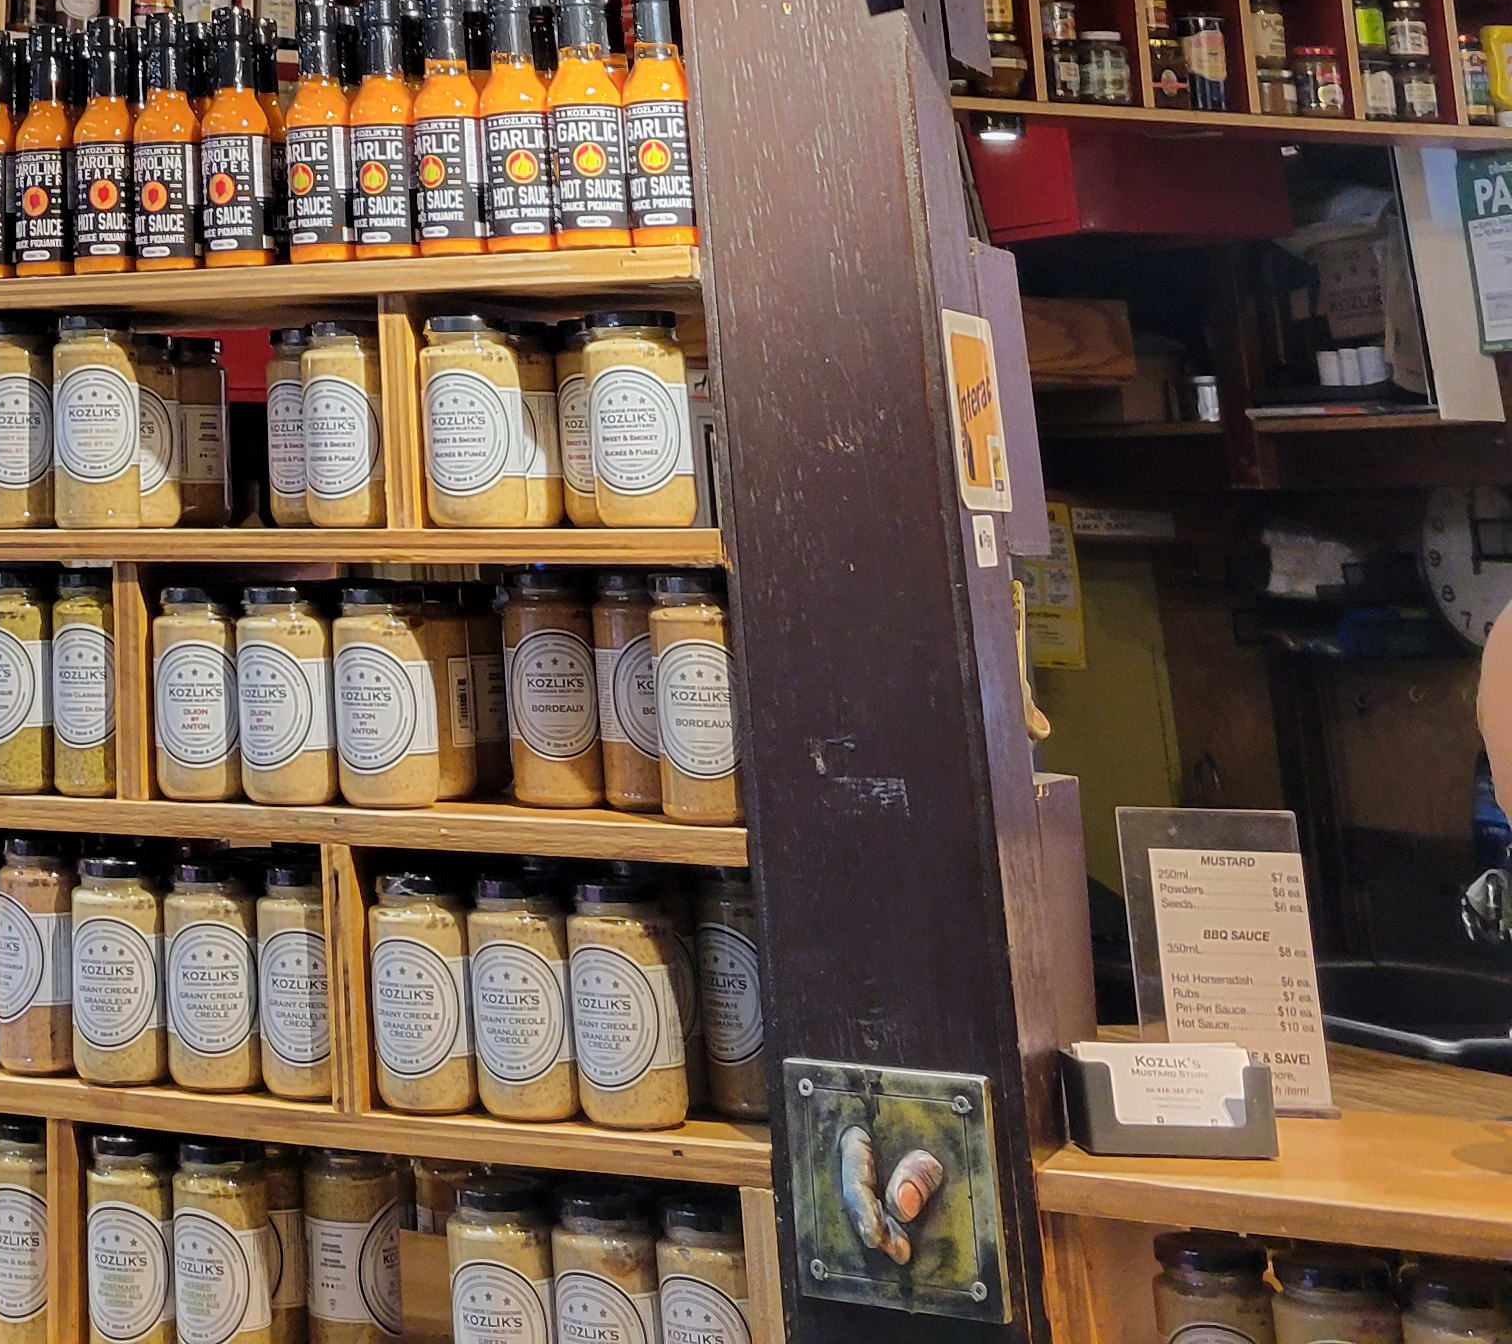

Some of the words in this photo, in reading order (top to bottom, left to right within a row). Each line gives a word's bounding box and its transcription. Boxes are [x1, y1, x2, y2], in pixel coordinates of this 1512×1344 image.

[557, 121, 618, 143] GARLIC
[627, 118, 685, 140] GARLIC
[489, 130, 545, 151] GARLIC
[560, 179, 583, 200] HOT
[585, 179, 623, 199] SAUCE
[650, 176, 691, 198] SAUCE
[426, 190, 464, 209] SAUCE
[493, 187, 515, 207] HOT
[296, 196, 332, 216] SAUCE
[367, 196, 406, 215] SAUCE
[587, 201, 624, 212] PIQUANTE
[652, 197, 693, 209] PIQUANTE
[217, 206, 252, 225] SAUCE
[29, 218, 64, 237] SAUCE
[78, 213, 95, 231] HOT
[150, 214, 184, 232] SAUCE
[369, 218, 407, 228] PIQUANTE
[432, 414, 486, 426] KOZLIK'S
[527, 678, 584, 688] KOZLIK'S
[670, 690, 731, 703] KOZLIK'S
[532, 704, 585, 712] BORDEAUX
[675, 718, 732, 728] BORDEAUX
[1200, 856, 1255, 867] MUSTARD
[1160, 884, 1204, 895] Powders
[1162, 900, 1193, 909] Seeds
[1203, 930, 1228, 940] BBQ
[1231, 931, 1270, 941] SAUCE
[81, 964, 134, 976] KOZLIK'S
[182, 970, 239, 981] KOZLIK'S
[1171, 973, 1189, 983] Hot
[1193, 974, 1253, 985] Horseradish
[179, 992, 207, 1000] GRAINY
[209, 991, 244, 1000] CREOLE
[379, 988, 434, 1001] KOZLIK'S
[481, 992, 540, 1005] KOZLIK'S
[1173, 989, 1200, 999] Rubs
[84, 996, 132, 1005] GRANULEUX
[186, 1002, 238, 1010] GRANULEUX
[269, 1000, 298, 1008] GRAINY
[577, 998, 632, 1011] KOZLIK'S
[90, 1004, 123, 1013] CREOLE
[1215, 1004, 1246, 1015] Sauce
[1278, 1007, 1297, 1017] $10
[275, 1011, 327, 1020] GRANULEUX
[403, 1012, 440, 1020] CREOLE
[508, 1016, 546, 1025] CREOLE
[283, 1019, 318, 1028] CREOLE
[383, 1022, 433, 1031] GRANULEUX
[602, 1022, 638, 1031] CREOLE
[1177, 1019, 1197, 1029] Hot
[1201, 1020, 1230, 1030] Sauce
[1280, 1022, 1299, 1032] $10
[389, 1030, 423, 1039] CREOLE
[487, 1027, 540, 1037] GRANULEUX
[582, 1032, 631, 1042] GRANULEUX
[494, 1036, 530, 1044] CREOLE
[588, 1040, 622, 1050] CREOLE
[1275, 1053, 1310, 1065] SAVE!
[463, 1314, 523, 1328] KOZLIK'S
[562, 1323, 620, 1341] KOZLIK'S
